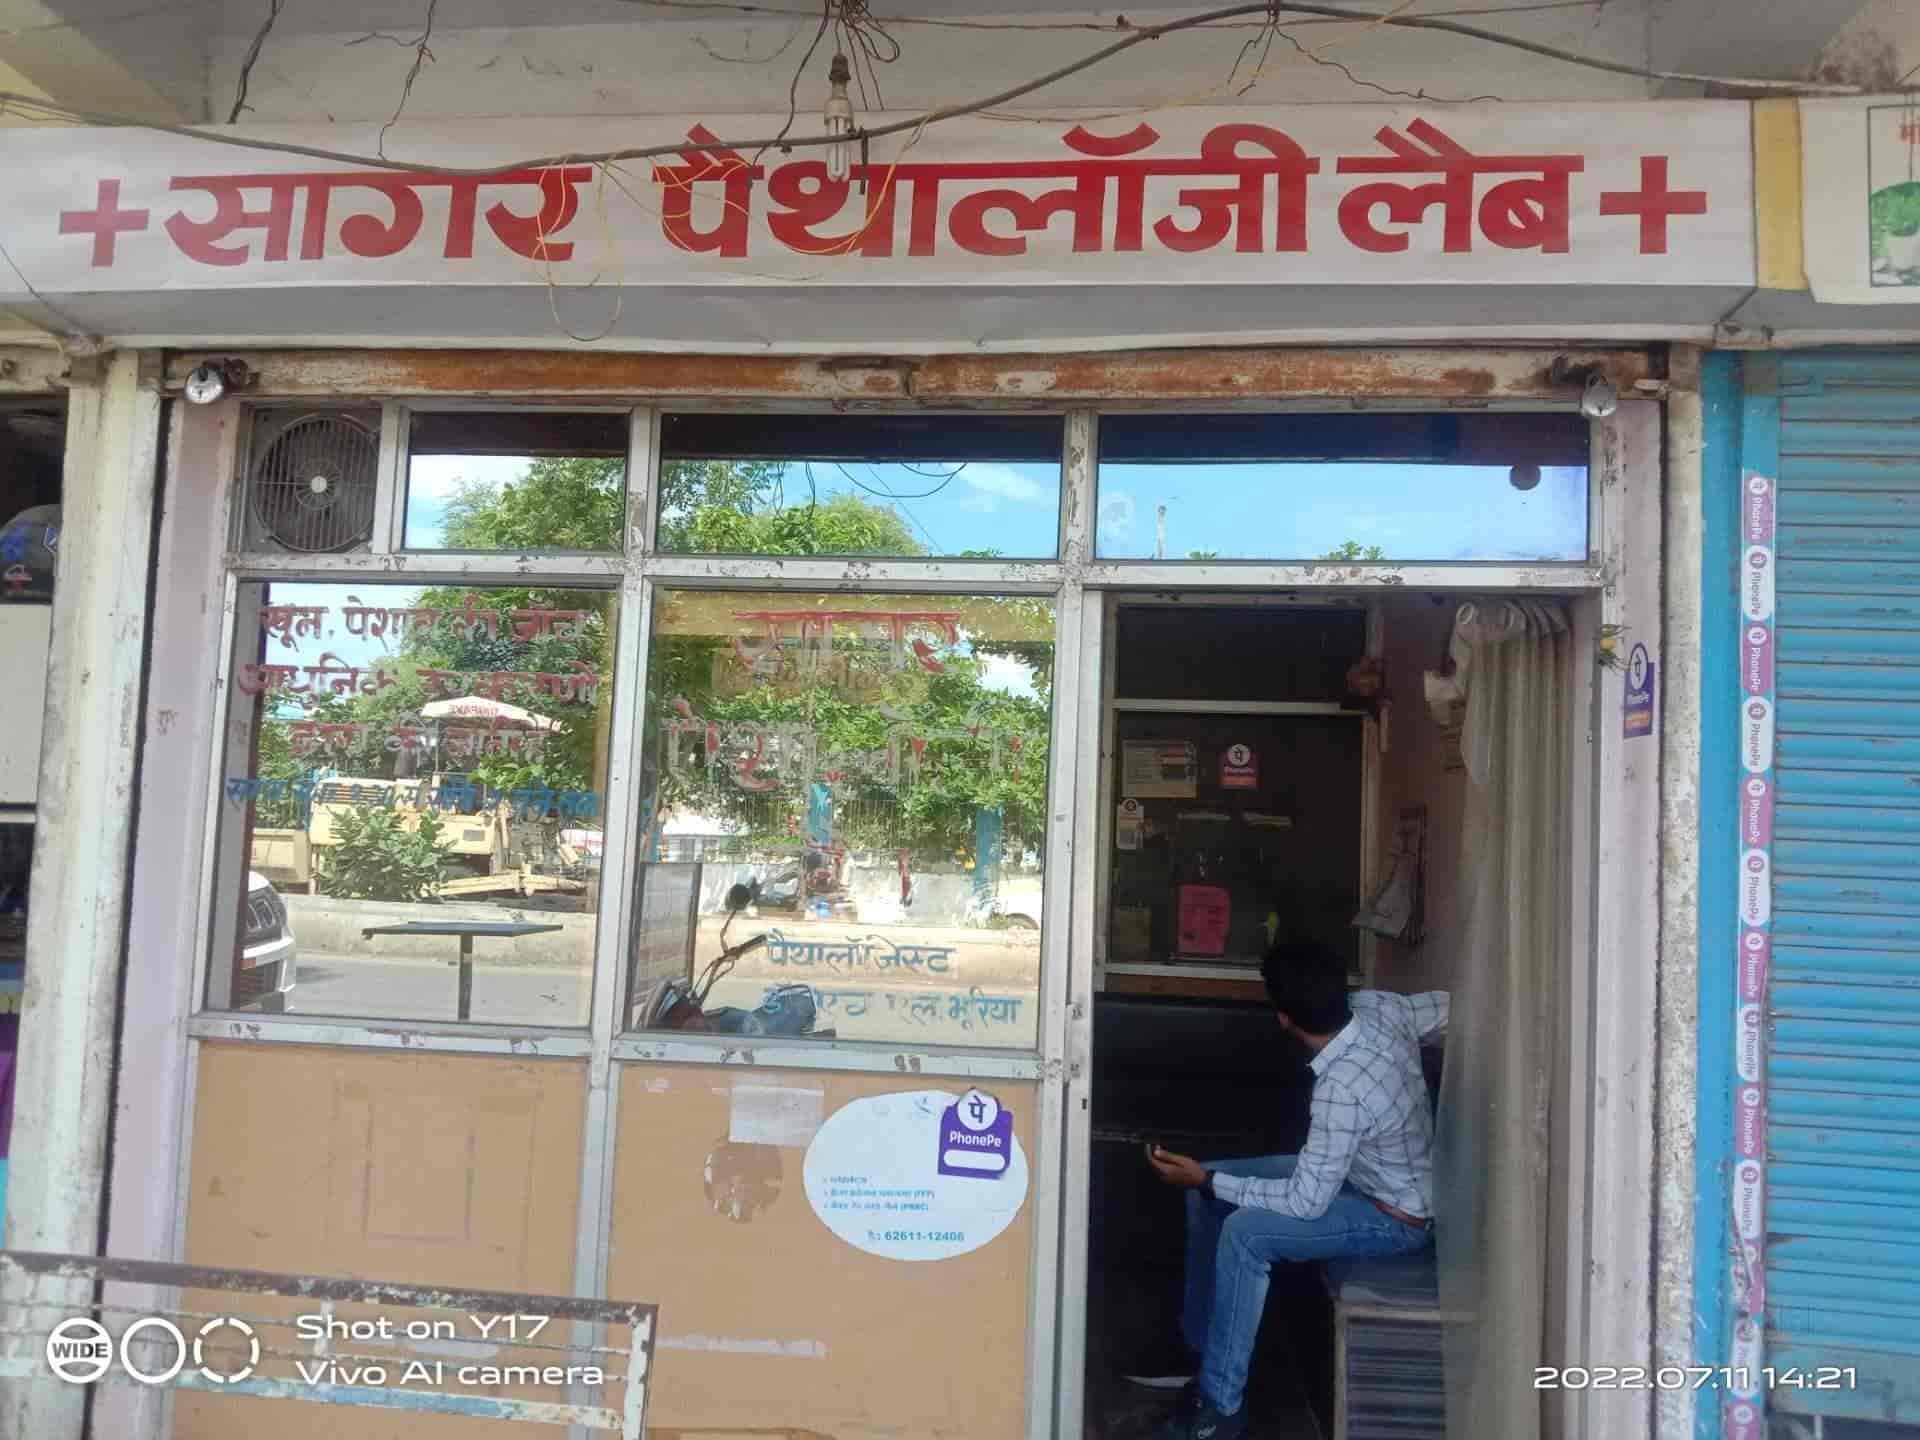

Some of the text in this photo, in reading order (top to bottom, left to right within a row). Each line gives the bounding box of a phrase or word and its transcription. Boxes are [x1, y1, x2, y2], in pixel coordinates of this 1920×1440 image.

[164, 117, 1584, 267] सागर पैथालॉजी लैब
[1751, 497, 1762, 540] PhonePe
[1751, 572, 1761, 616] PhonePe
[1751, 647, 1761, 692] PhonePe
[968, 1095, 987, 1123] पे
[1744, 1107, 1754, 1154] PhonePe
[949, 1129, 1002, 1148] PhonePe
